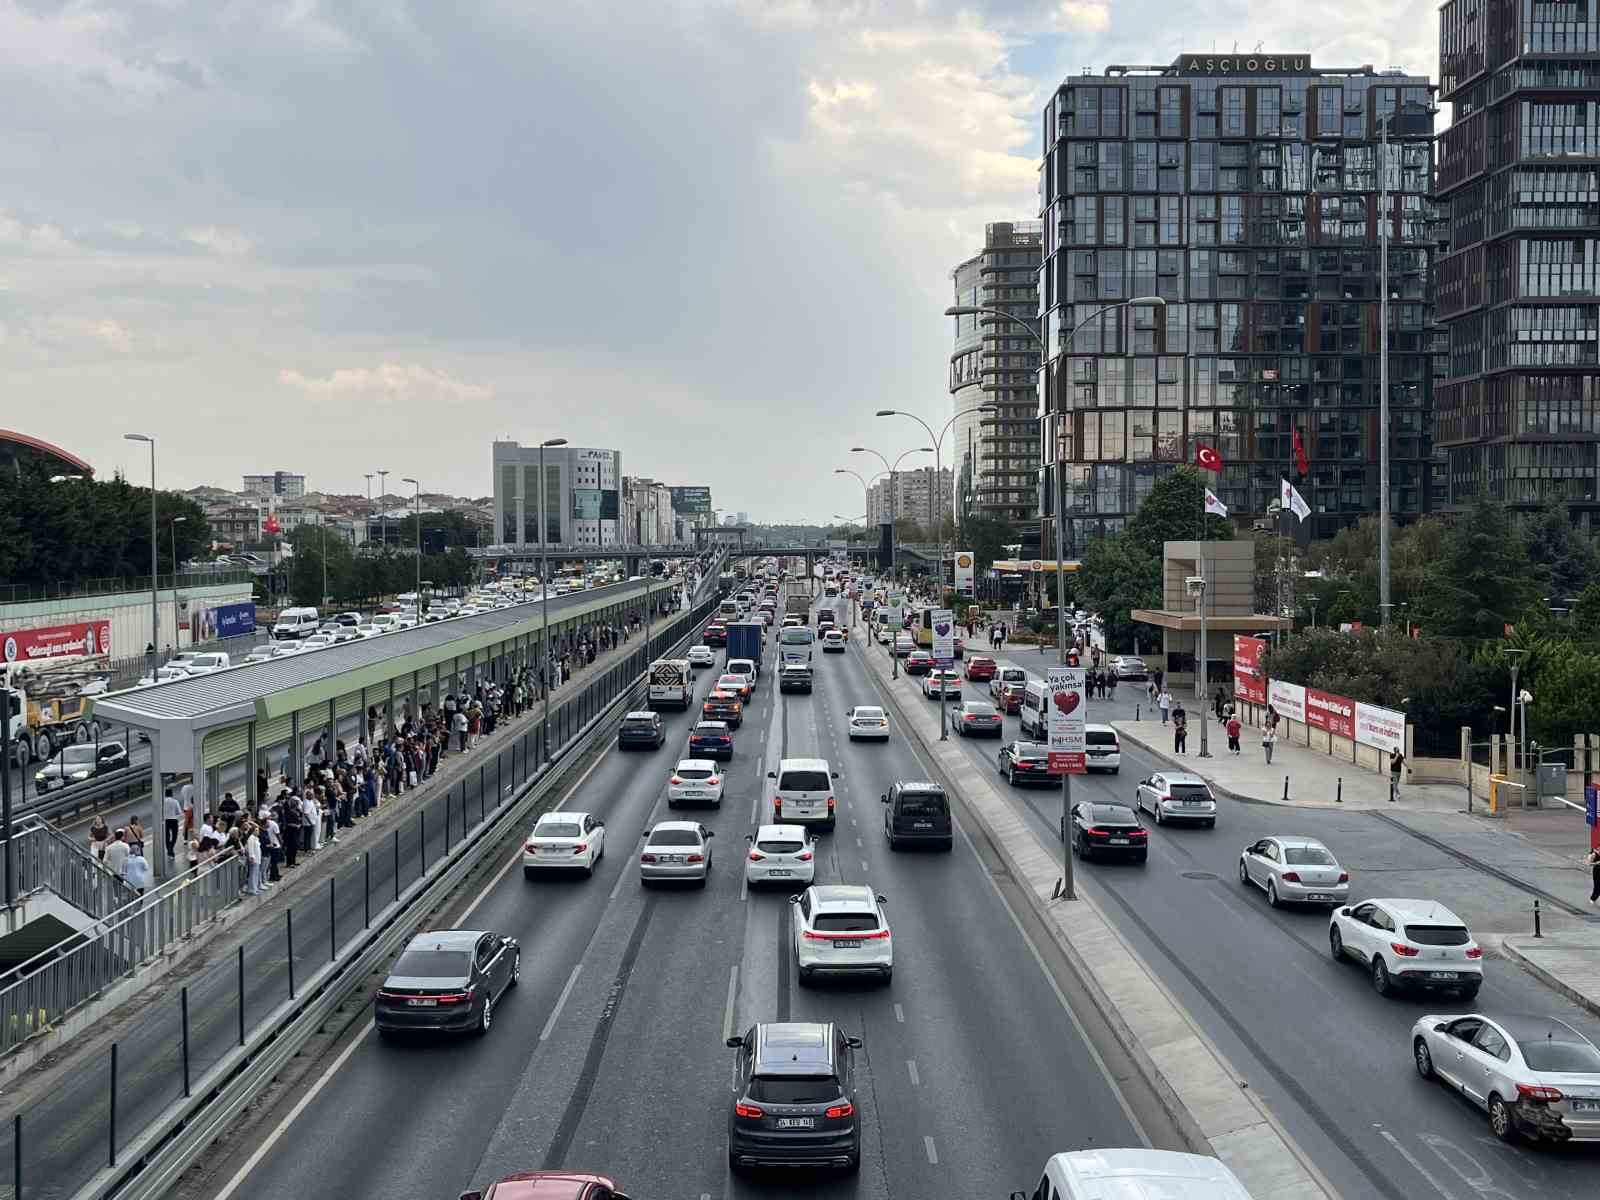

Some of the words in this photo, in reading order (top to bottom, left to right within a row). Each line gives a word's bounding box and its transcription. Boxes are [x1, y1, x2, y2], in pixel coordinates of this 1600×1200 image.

[1189, 56, 1304, 75] AŞÇIOĞLU
[1049, 675, 1059, 683] Ya
[1060, 672, 1076, 684] çok
